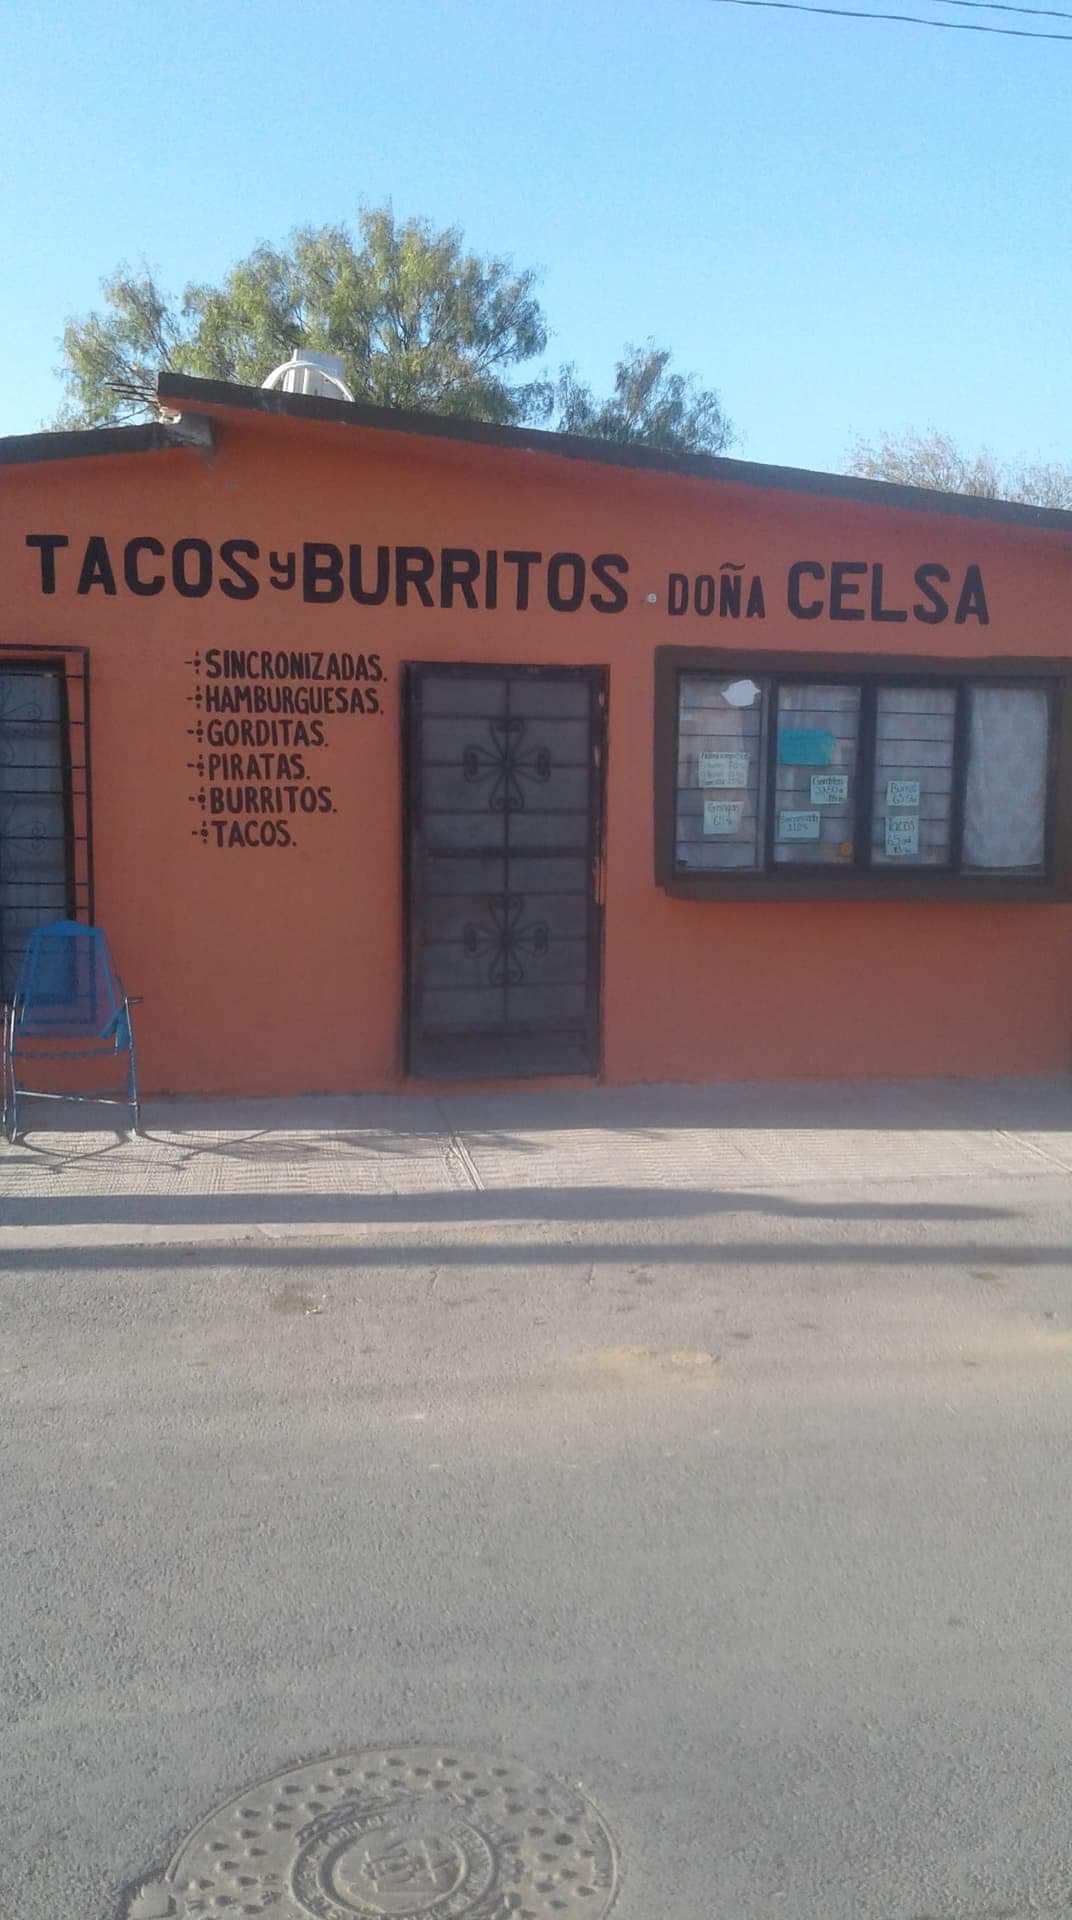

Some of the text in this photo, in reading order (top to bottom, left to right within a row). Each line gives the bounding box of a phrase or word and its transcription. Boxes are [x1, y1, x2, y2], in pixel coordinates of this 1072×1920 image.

[25, 534, 261, 600] TACOS
[302, 541, 630, 615] BURRITOS
[667, 561, 766, 619] DOÑA
[786, 559, 990, 626] CELSA
[204, 648, 388, 682] SINCRONIZADAS.
[204, 684, 385, 716] HAMBURGUESAS.
[206, 718, 329, 748] GORDITAS.
[207, 752, 311, 782] PIRATAS.
[208, 785, 338, 815] BURRITOS.
[209, 819, 297, 848] TACOS.
